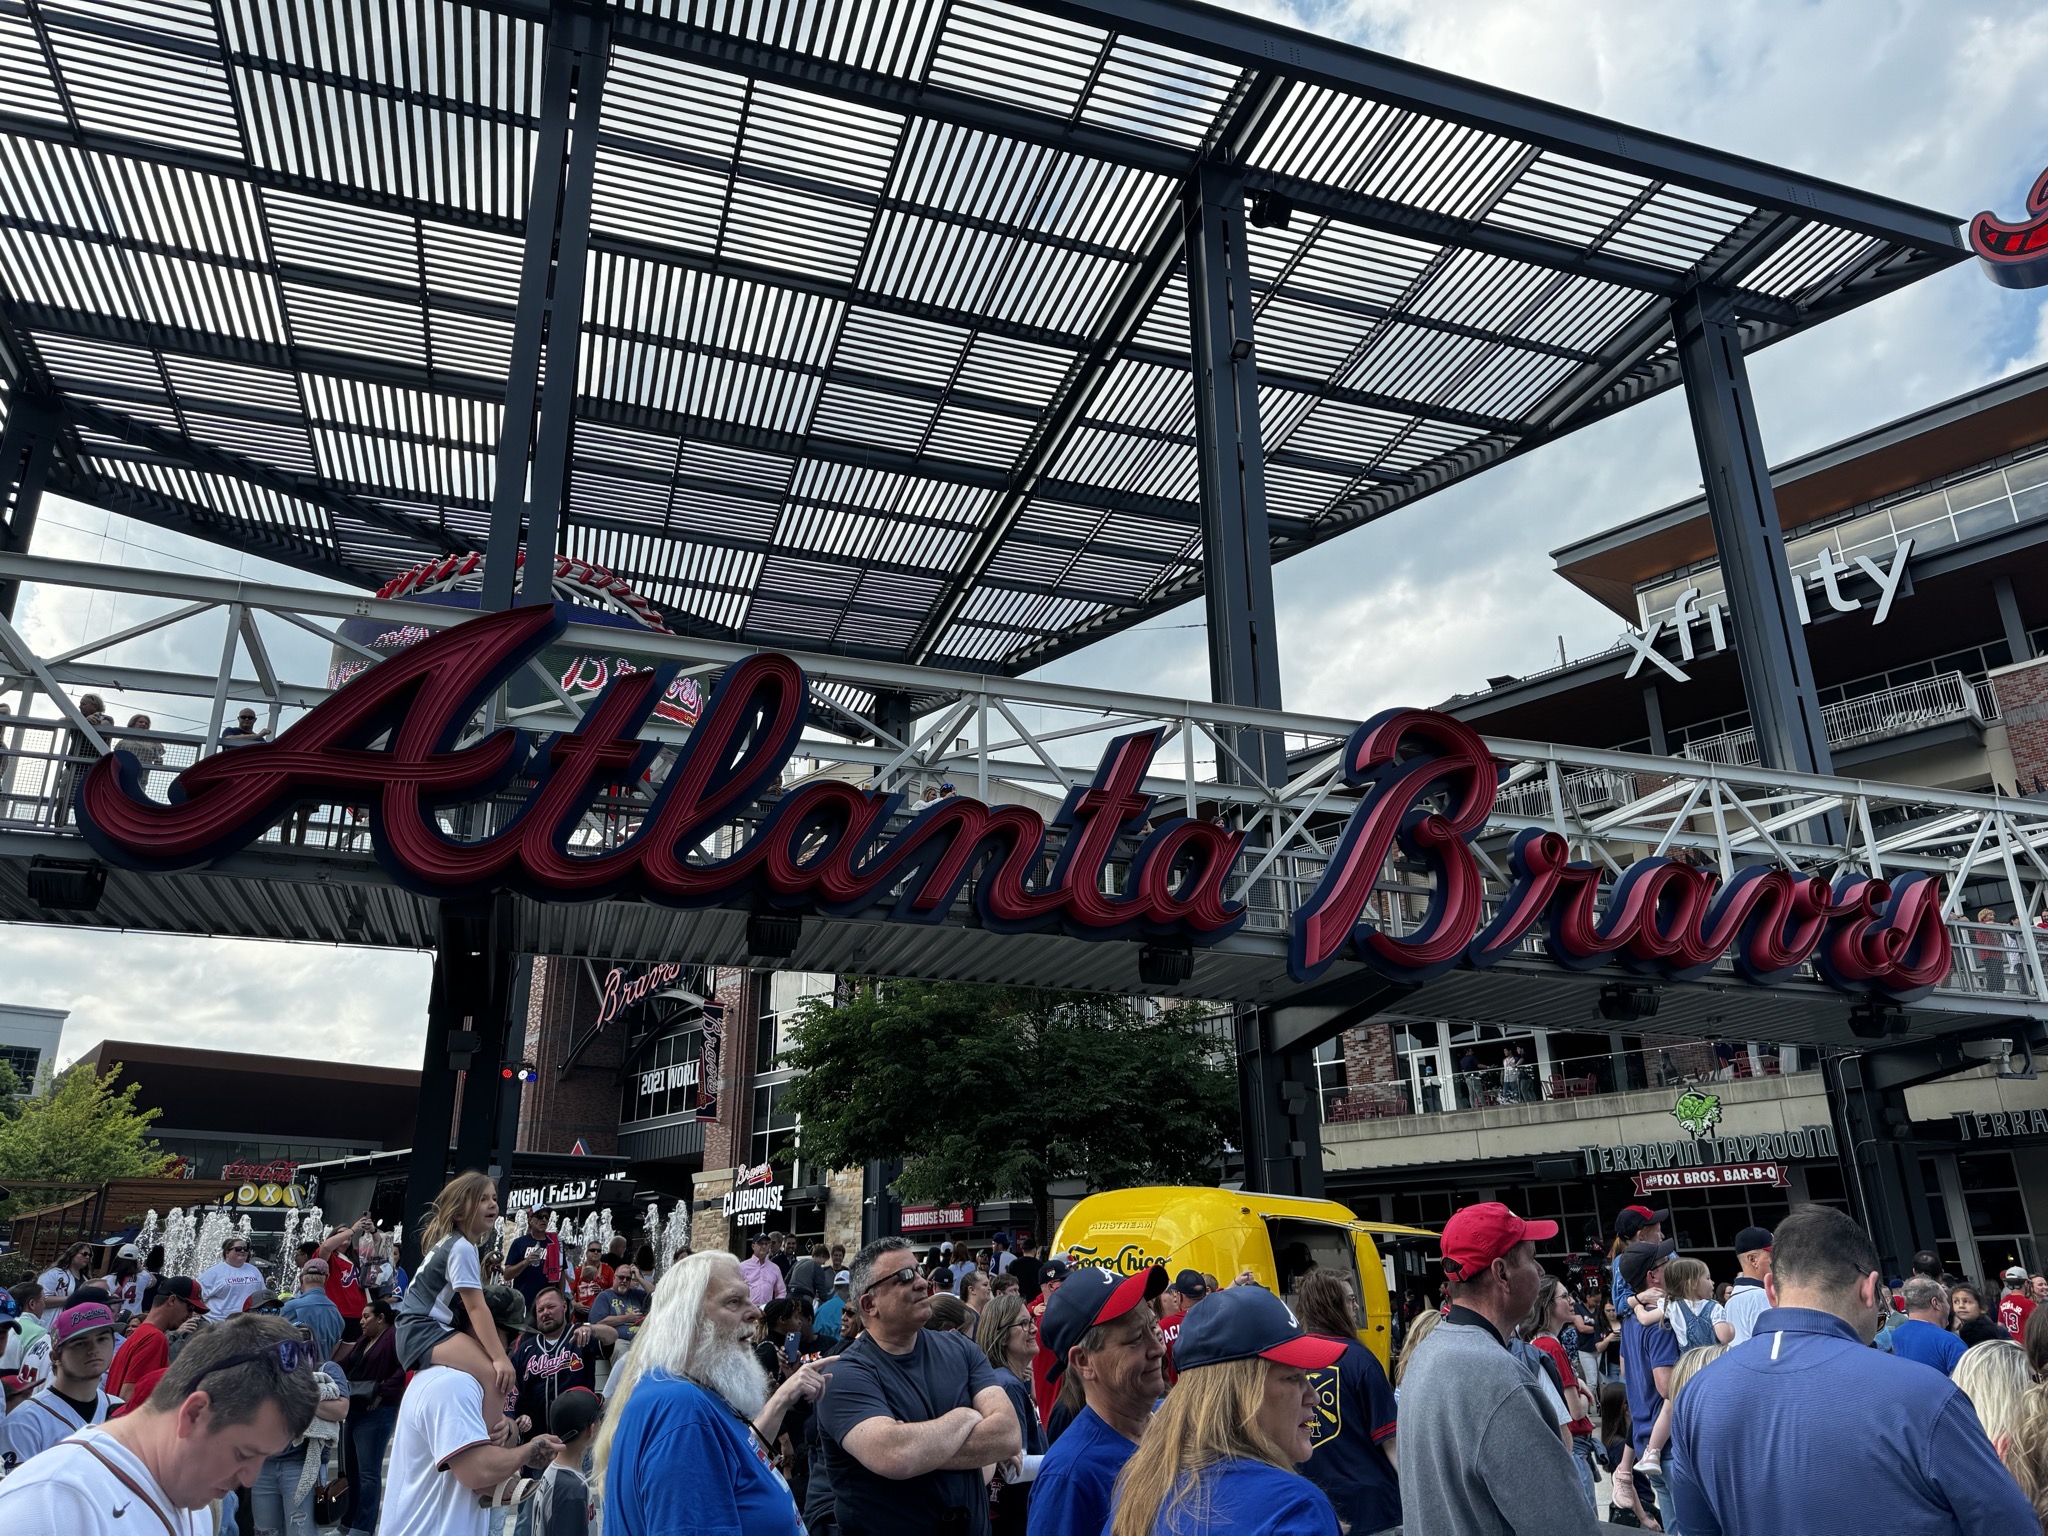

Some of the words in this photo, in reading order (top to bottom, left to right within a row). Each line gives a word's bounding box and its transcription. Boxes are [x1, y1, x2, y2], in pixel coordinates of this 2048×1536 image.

[1619, 538, 1915, 683] xfiity
[76, 603, 1249, 943] Atlanta
[1288, 706, 1952, 1000] Braves
[640, 1070, 665, 1096] 2021
[1578, 1138, 1703, 1175] TERRAPIN
[1707, 1124, 1839, 1165] TAPROOM
[1657, 1172, 1681, 1186] FOX
[1684, 1170, 1720, 1185] BROS.
[1724, 1165, 1777, 1182] BAR-B-Q
[549, 1180, 586, 1204] FIELD
[722, 1184, 784, 1218] CLUBHOUSE
[736, 1211, 767, 1227] STORE
[938, 1208, 965, 1224] STORE
[1090, 1221, 1154, 1231] AIRSTREAM
[1117, 1244, 1172, 1277] Chico
[2003, 1311, 2019, 1333] 13
